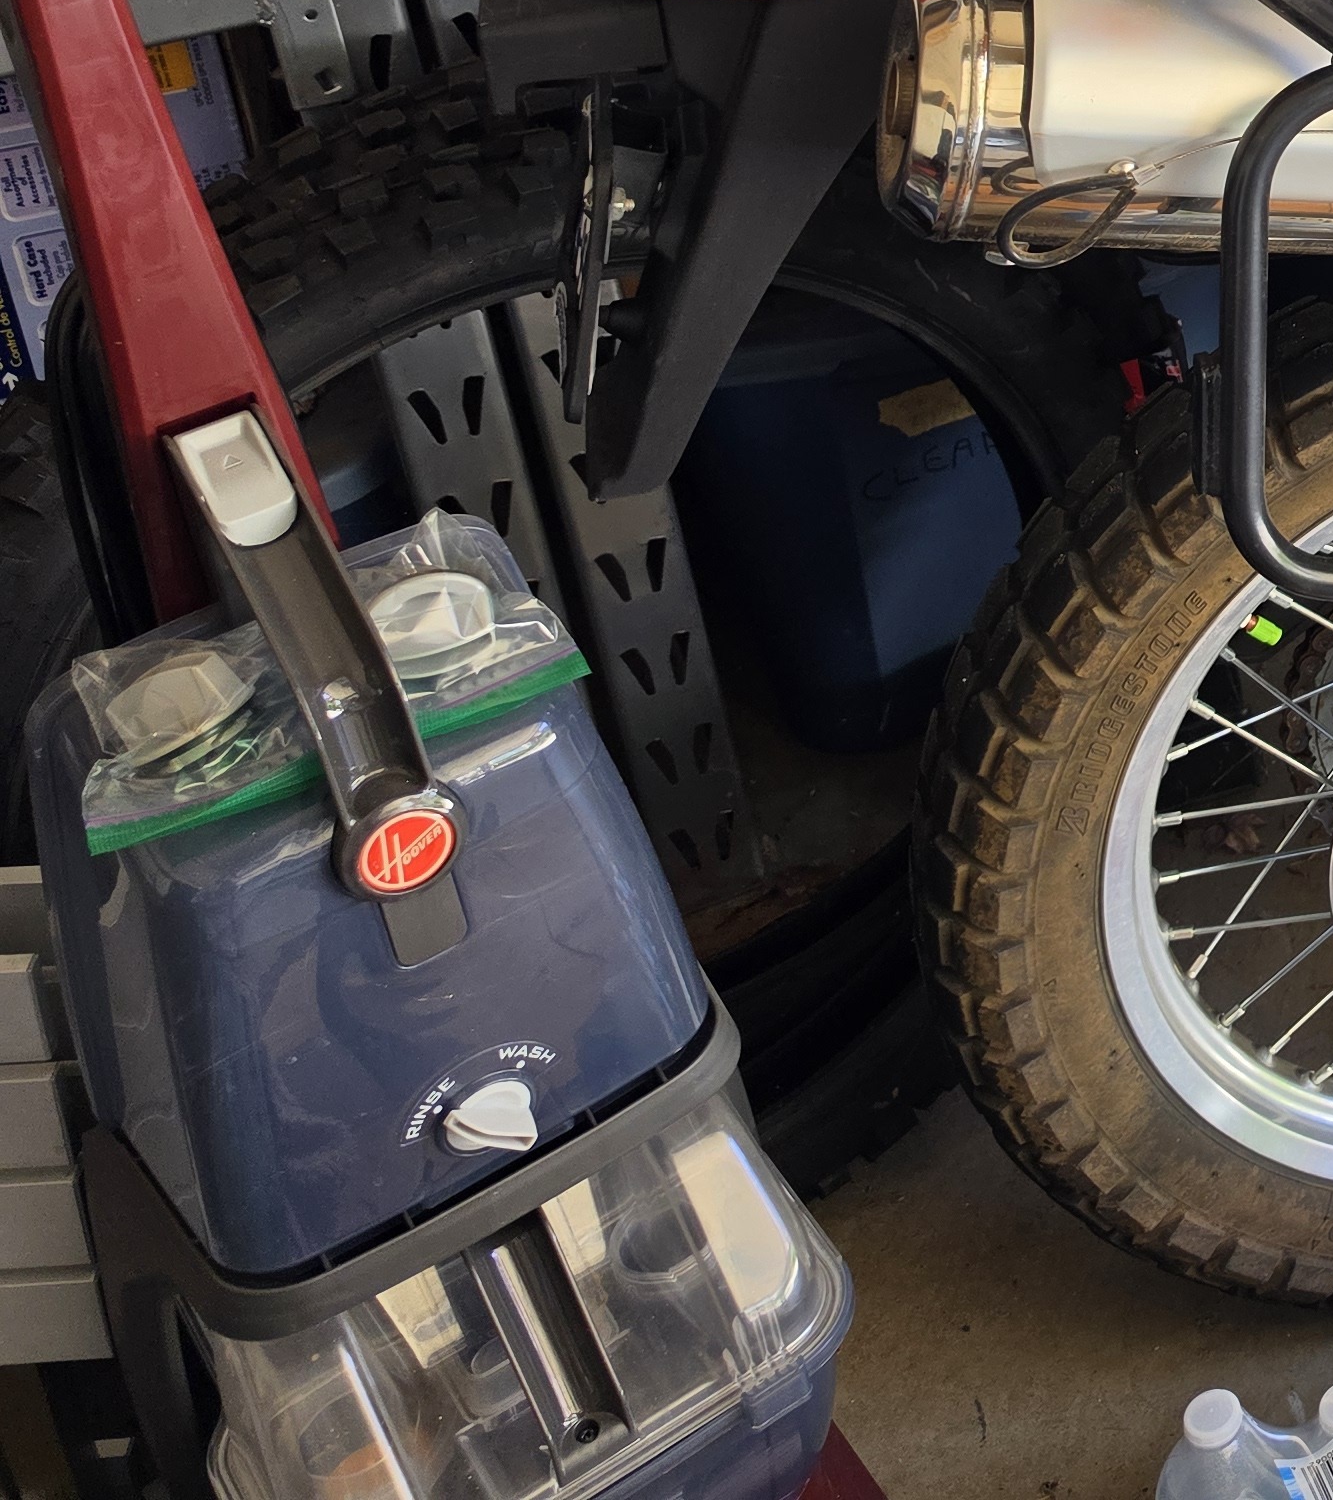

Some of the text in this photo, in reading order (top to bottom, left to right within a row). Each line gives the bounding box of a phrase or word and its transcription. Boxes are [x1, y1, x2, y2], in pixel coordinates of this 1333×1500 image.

[4, 157, 26, 208] Assortment
[16, 176, 28, 187] of
[21, 154, 41, 205] Accessories
[24, 240, 48, 299] Hard Case
[37, 248, 55, 286] Included
[5, 328, 23, 368] Control
[1055, 589, 1208, 837] BRIDGESTONE
[379, 823, 443, 884] HOOVER
[499, 1044, 557, 1064] WASH
[405, 1077, 456, 1140] RINSE
